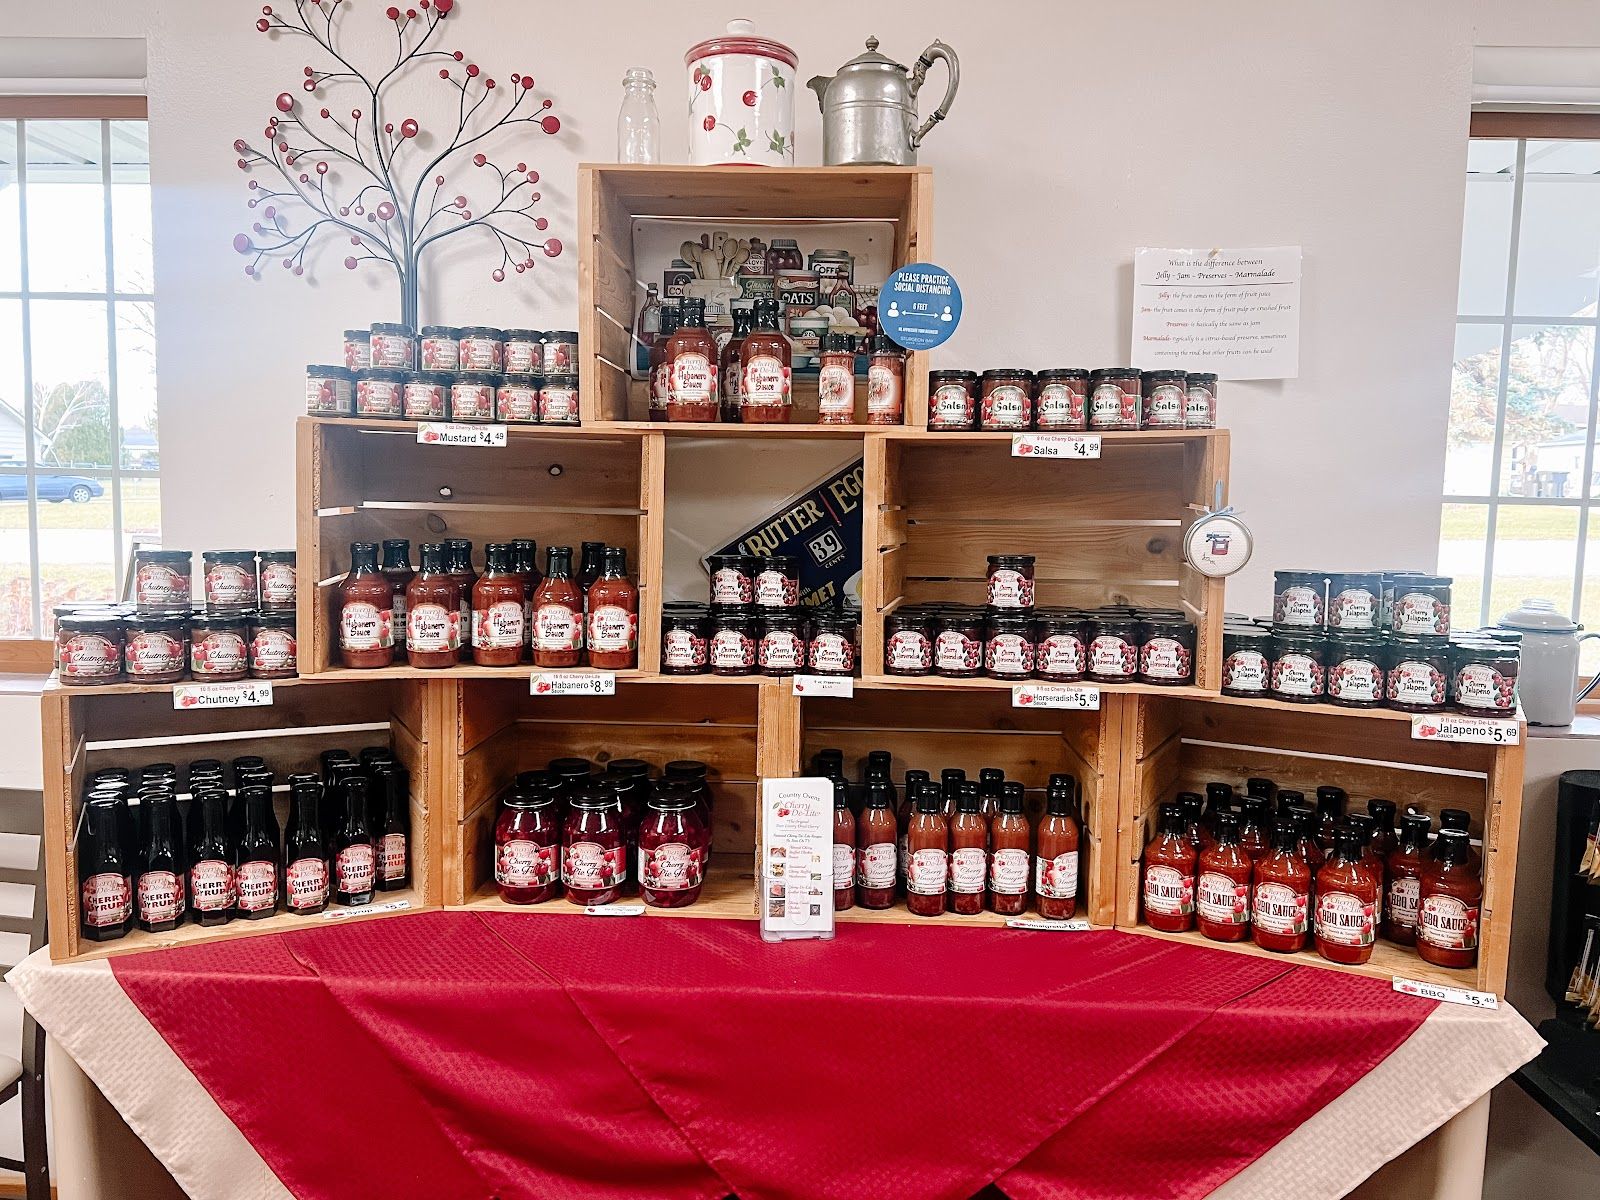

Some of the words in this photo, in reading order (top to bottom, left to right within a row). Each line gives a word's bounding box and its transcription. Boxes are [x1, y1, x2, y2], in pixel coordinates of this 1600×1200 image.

[1168, 259, 1185, 267] What
[1203, 259, 1234, 269] difference
[813, 264, 839, 276] COFF
[1155, 271, 1171, 280] Jelly
[1235, 269, 1275, 278] Marmalade
[899, 272, 920, 283] PLEASE
[921, 274, 949, 285] PRACTICE
[894, 282, 914, 292] SOCIAL
[916, 283, 951, 295] DISTANCING
[782, 292, 814, 304] OATS
[677, 370, 707, 383] Habanero
[750, 371, 779, 384] Habanero
[683, 381, 703, 389] Sauce
[755, 383, 775, 391] Sauce
[996, 402, 1022, 412] Salsa
[1041, 401, 1070, 411] Salsa
[1092, 401, 1120, 412] Salsa
[1153, 402, 1180, 411] Salsa
[439, 433, 476, 443] Mustard
[480, 432, 504, 445] $4.49
[1034, 446, 1058, 455] Salsa
[1074, 443, 1099, 456] $4.99
[745, 499, 824, 556] BUTTER
[812, 533, 838, 560] 39
[825, 554, 845, 569] CENTS
[142, 582, 171, 592] Chutney
[214, 583, 242, 593] Chutney
[268, 582, 295, 591] Chutney
[800, 581, 836, 606] MET
[1289, 606, 1311, 614] Jalapeno
[1293, 601, 1309, 609] Cherry
[493, 618, 521, 629] Habanero
[1406, 614, 1431, 623] Jalapeno
[345, 618, 376, 630] Habanero
[415, 619, 445, 631] Habanero
[541, 620, 570, 631] Habanero
[597, 621, 626, 632] Habanero
[350, 627, 371, 638] Sauce
[419, 629, 440, 639] Sauce
[499, 627, 518, 637] Sauce
[545, 629, 564, 639] Sauce
[601, 629, 621, 639] Sauce
[139, 651, 169, 661] Chutney
[210, 651, 239, 660] Chutney
[259, 648, 288, 657] Chutney
[73, 654, 105, 663] Chutney
[1236, 671, 1259, 680] Jalapeno
[1350, 675, 1367, 684] Cherry
[552, 681, 589, 689] Habanero
[590, 680, 613, 693] $8.99
[1345, 680, 1370, 689] Jalapeno
[1407, 678, 1424, 686] Cherry
[1469, 681, 1486, 689] Cherry
[1402, 683, 1427, 692] Jalapeno
[1465, 686, 1490, 696] Jalapeno
[198, 695, 240, 704] Chutney
[243, 689, 269, 702] $4.99
[1075, 693, 1098, 707] $5.69
[1437, 724, 1486, 736] Jalapeno
[1488, 727, 1516, 742] $5.69
[803, 793, 820, 801] Ovens
[508, 858, 533, 868] Cherry
[574, 859, 599, 869] Cherry
[660, 860, 685, 870] Cherry
[194, 881, 227, 889] CHERRY
[240, 880, 274, 890] CHERRY
[291, 878, 325, 888] CHERRY
[196, 888, 226, 896] SYRUP
[242, 888, 271, 897] SYRUP
[294, 885, 323, 894] SYRUP
[1161, 885, 1184, 898] SAUCE
[88, 894, 124, 905] CHERRY
[141, 892, 175, 901] CHERRY
[1212, 892, 1236, 907] SAUCE
[90, 901, 124, 912] SYRUP
[143, 899, 173, 909] SYRUP
[1272, 903, 1298, 918] SAUCE
[1322, 909, 1338, 924] BBQ
[1339, 913, 1364, 928] SAUCE
[1423, 910, 1439, 927] BBQ
[1440, 916, 1468, 931] SAUCE
[1421, 988, 1446, 999] BBQ
[1466, 994, 1495, 1006] $5.49
